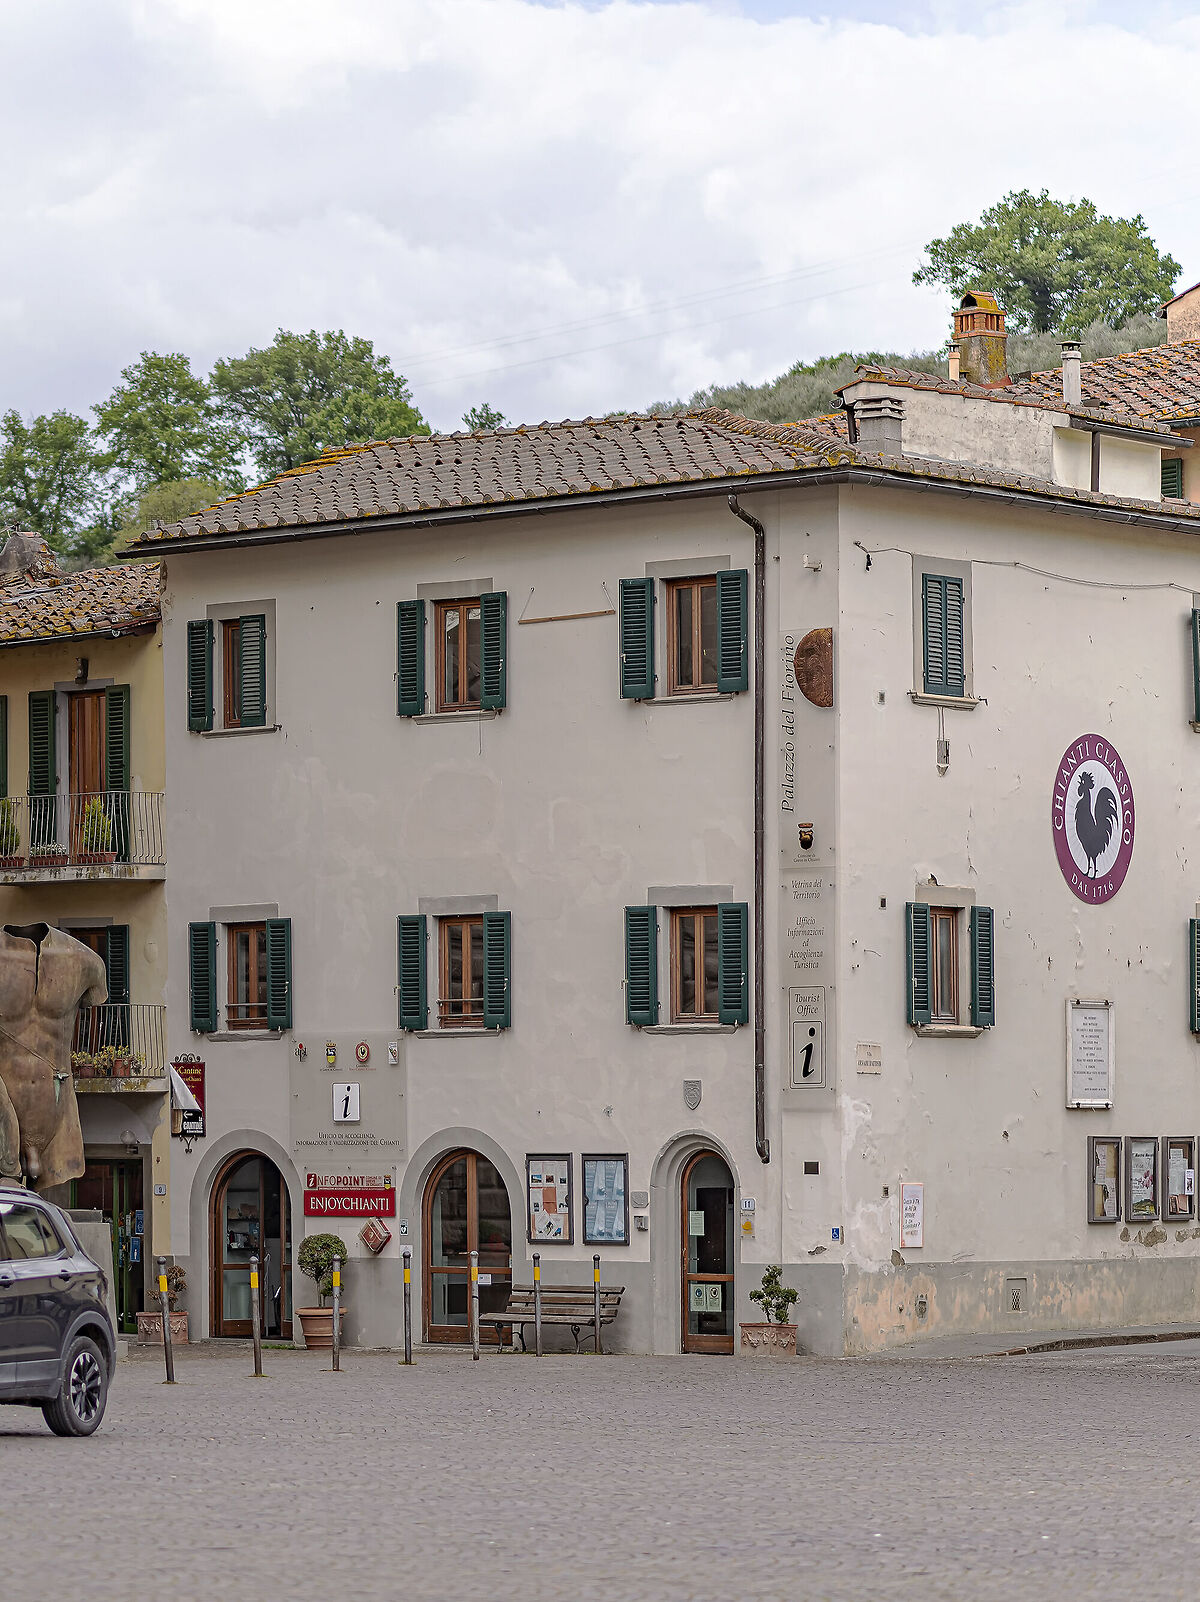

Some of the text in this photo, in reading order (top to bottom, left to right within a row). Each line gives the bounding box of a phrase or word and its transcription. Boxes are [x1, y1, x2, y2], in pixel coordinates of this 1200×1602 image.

[781, 634, 795, 813] Palazzo del Fiorino
[1054, 740, 1132, 845] CHIANTI CLASSICO
[791, 879, 822, 888] Vetrina del
[1071, 873, 1114, 898] DAL 1716
[793, 891, 821, 900] Territorio
[796, 917, 816, 928] Ufficio
[787, 927, 825, 939] Informazioni
[789, 949, 823, 960] Accoglienza
[793, 960, 819, 969] Turistica
[794, 993, 820, 1003] Tourist
[796, 1004, 819, 1017] Office
[310, 1196, 389, 1213] ENJOYCHIANTI
